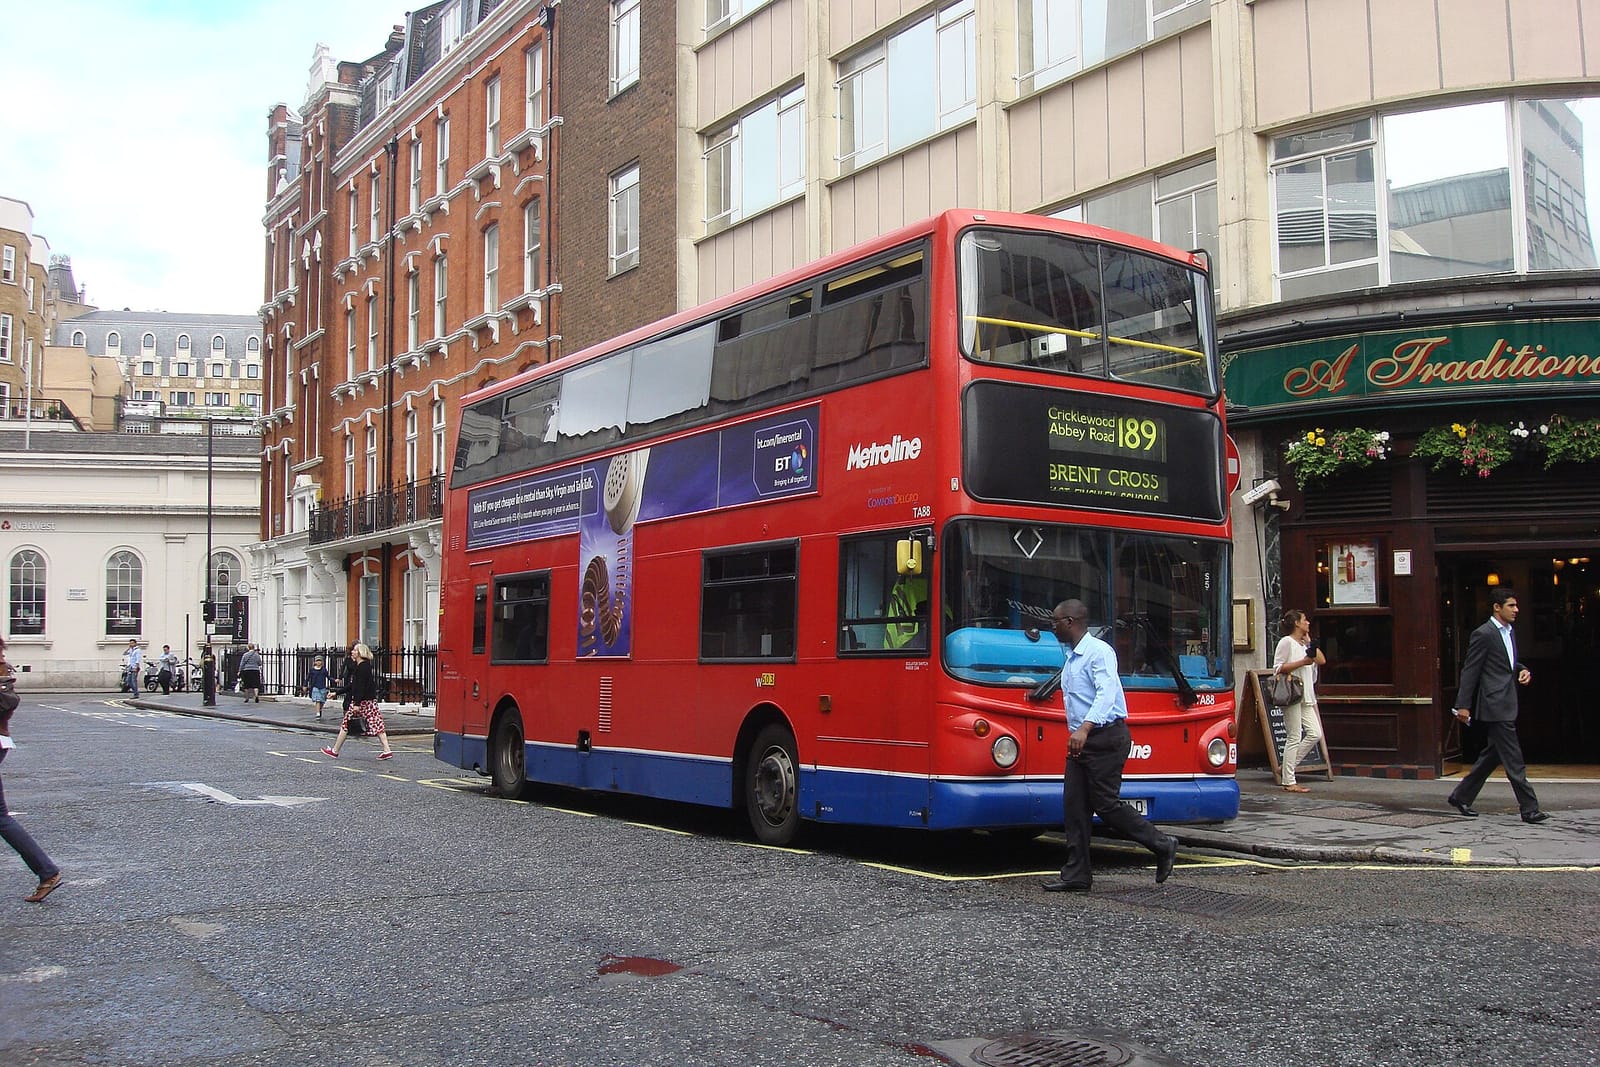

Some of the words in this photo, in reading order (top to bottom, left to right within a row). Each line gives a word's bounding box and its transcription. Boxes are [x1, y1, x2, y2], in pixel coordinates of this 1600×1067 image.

[1283, 343, 1359, 397] A
[756, 428, 802, 449] bt.com/linerental
[1048, 406, 1116, 429] Cricklewood
[1118, 416, 1157, 451] 189
[1049, 422, 1086, 441] Abbey
[1089, 427, 1115, 443] Road
[846, 434, 922, 471] Metroline
[775, 455, 792, 472] BT
[1049, 463, 1101, 484] BRENT
[1107, 469, 1159, 490] CROSS
[912, 505, 931, 518] TA88
[14, 520, 56, 531] NatWest
